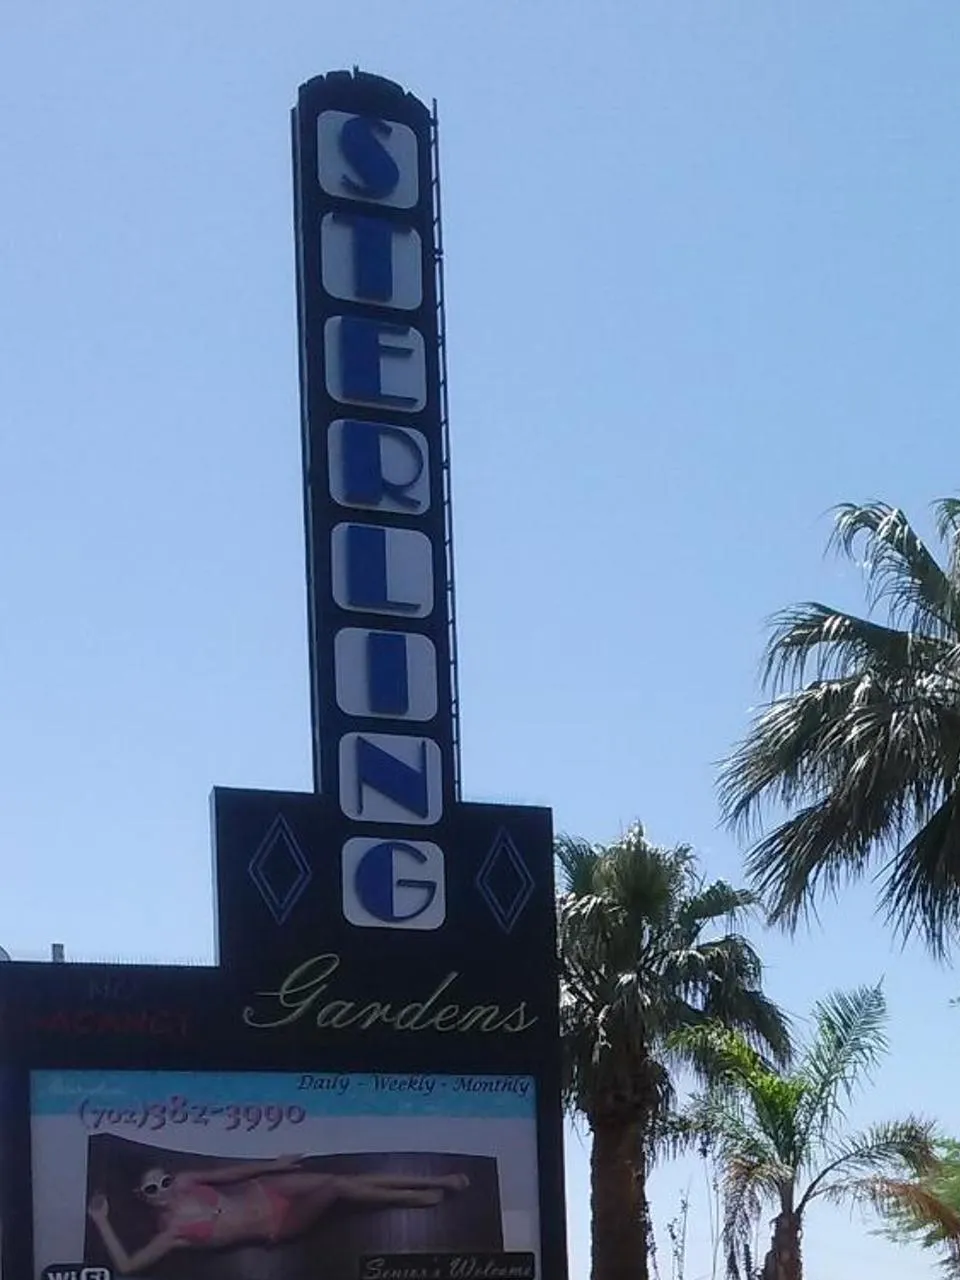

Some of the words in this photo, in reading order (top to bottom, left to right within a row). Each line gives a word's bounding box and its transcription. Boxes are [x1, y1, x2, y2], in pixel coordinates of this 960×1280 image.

[333, 113, 438, 925] STERLING
[244, 953, 538, 1034] Gardens
[297, 1074, 350, 1095] Daily
[370, 1074, 437, 1096] Weekly
[453, 1076, 531, 1097] Monthly
